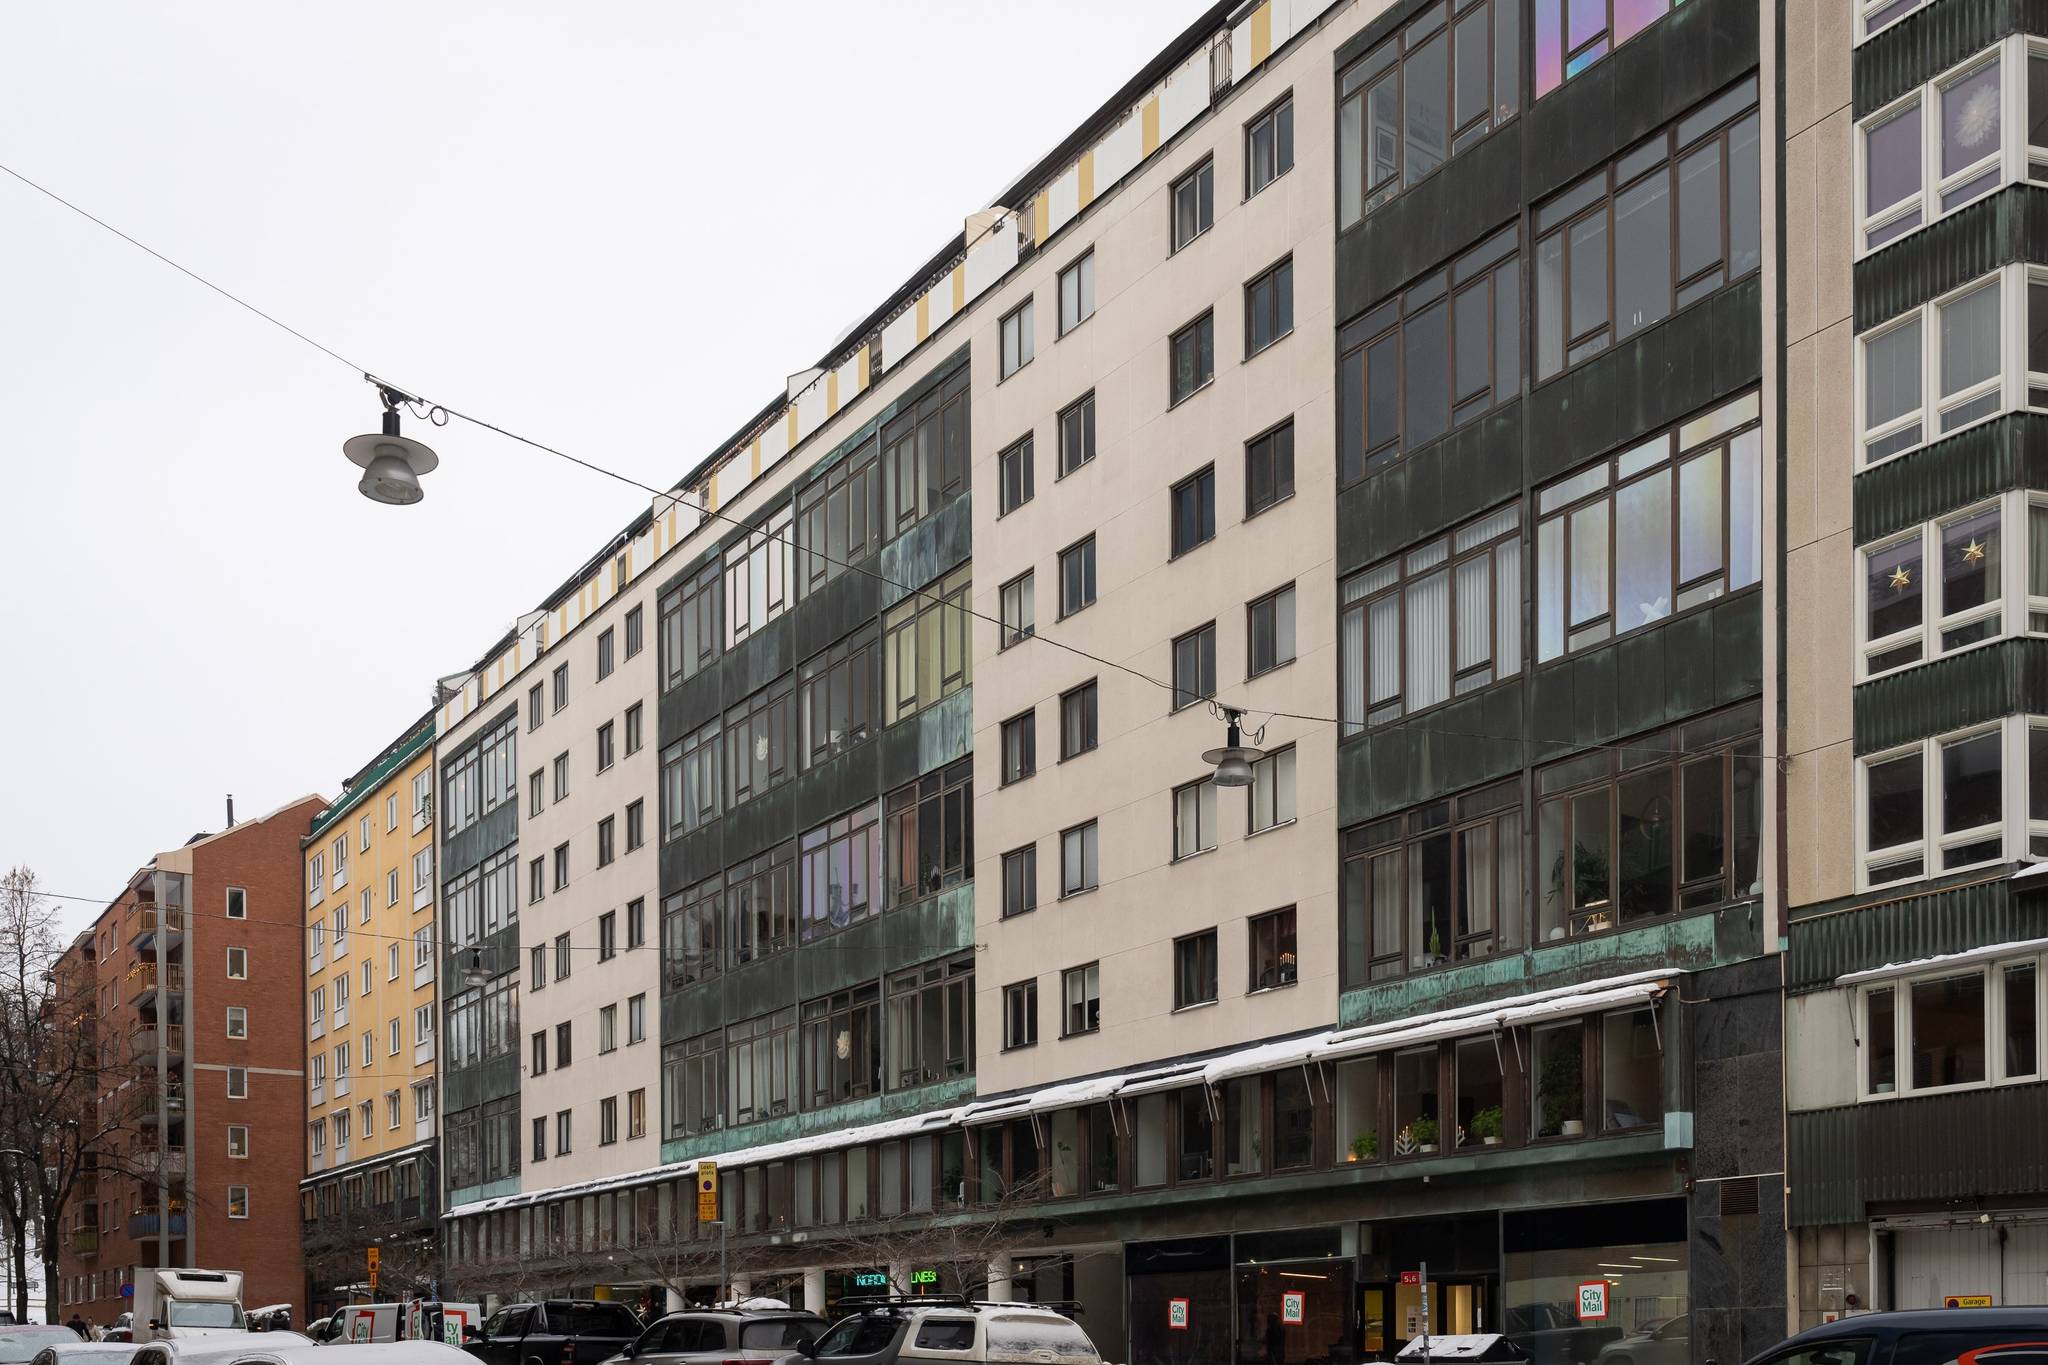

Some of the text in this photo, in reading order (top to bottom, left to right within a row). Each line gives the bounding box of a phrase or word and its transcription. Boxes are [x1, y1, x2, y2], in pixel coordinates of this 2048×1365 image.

[1582, 1289, 1602, 1302] City
[1285, 1298, 1300, 1309] City
[1582, 1301, 1602, 1312] Mail
[1963, 1298, 1986, 1306] Garage
[1172, 1304, 1185, 1315] City
[1285, 1308, 1300, 1319] Mail
[1172, 1313, 1185, 1322] Mail
